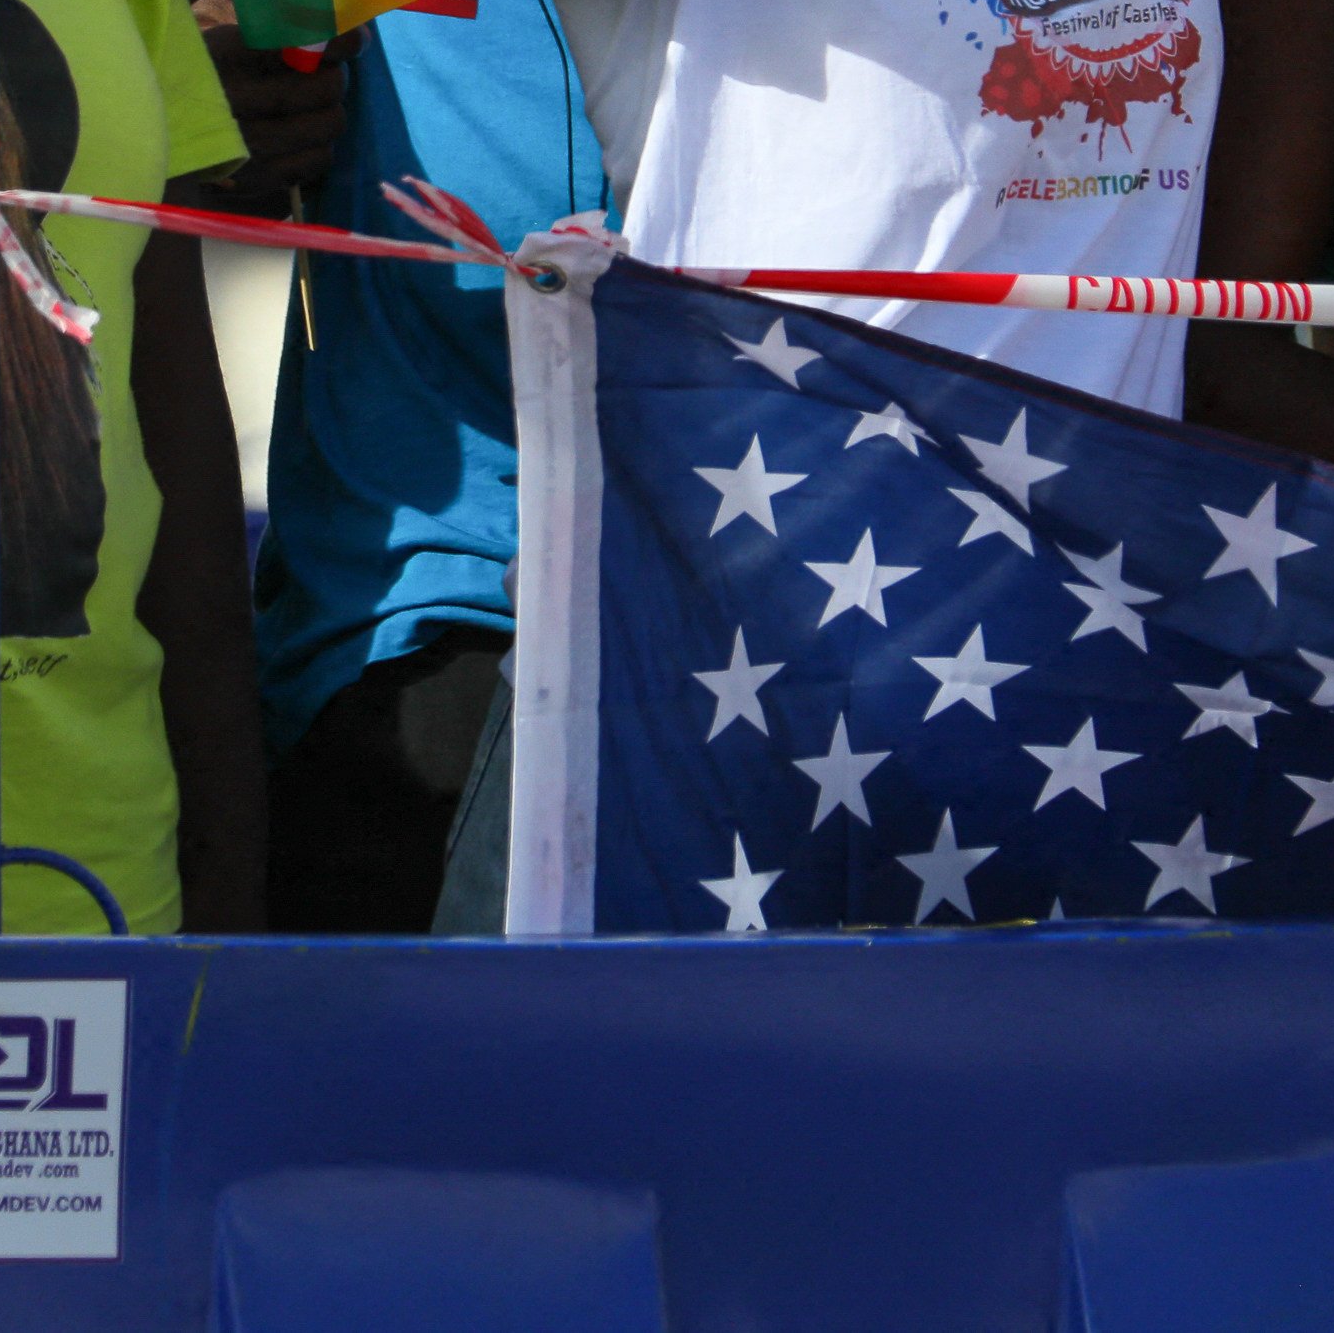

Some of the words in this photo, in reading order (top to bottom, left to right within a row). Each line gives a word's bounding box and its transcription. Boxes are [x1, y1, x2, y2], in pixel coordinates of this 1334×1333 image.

[1042, 8, 1103, 37] Festival
[1123, 2, 1179, 24] Castles
[1159, 168, 1190, 191] US
[68, 1130, 115, 1158] LTD.
